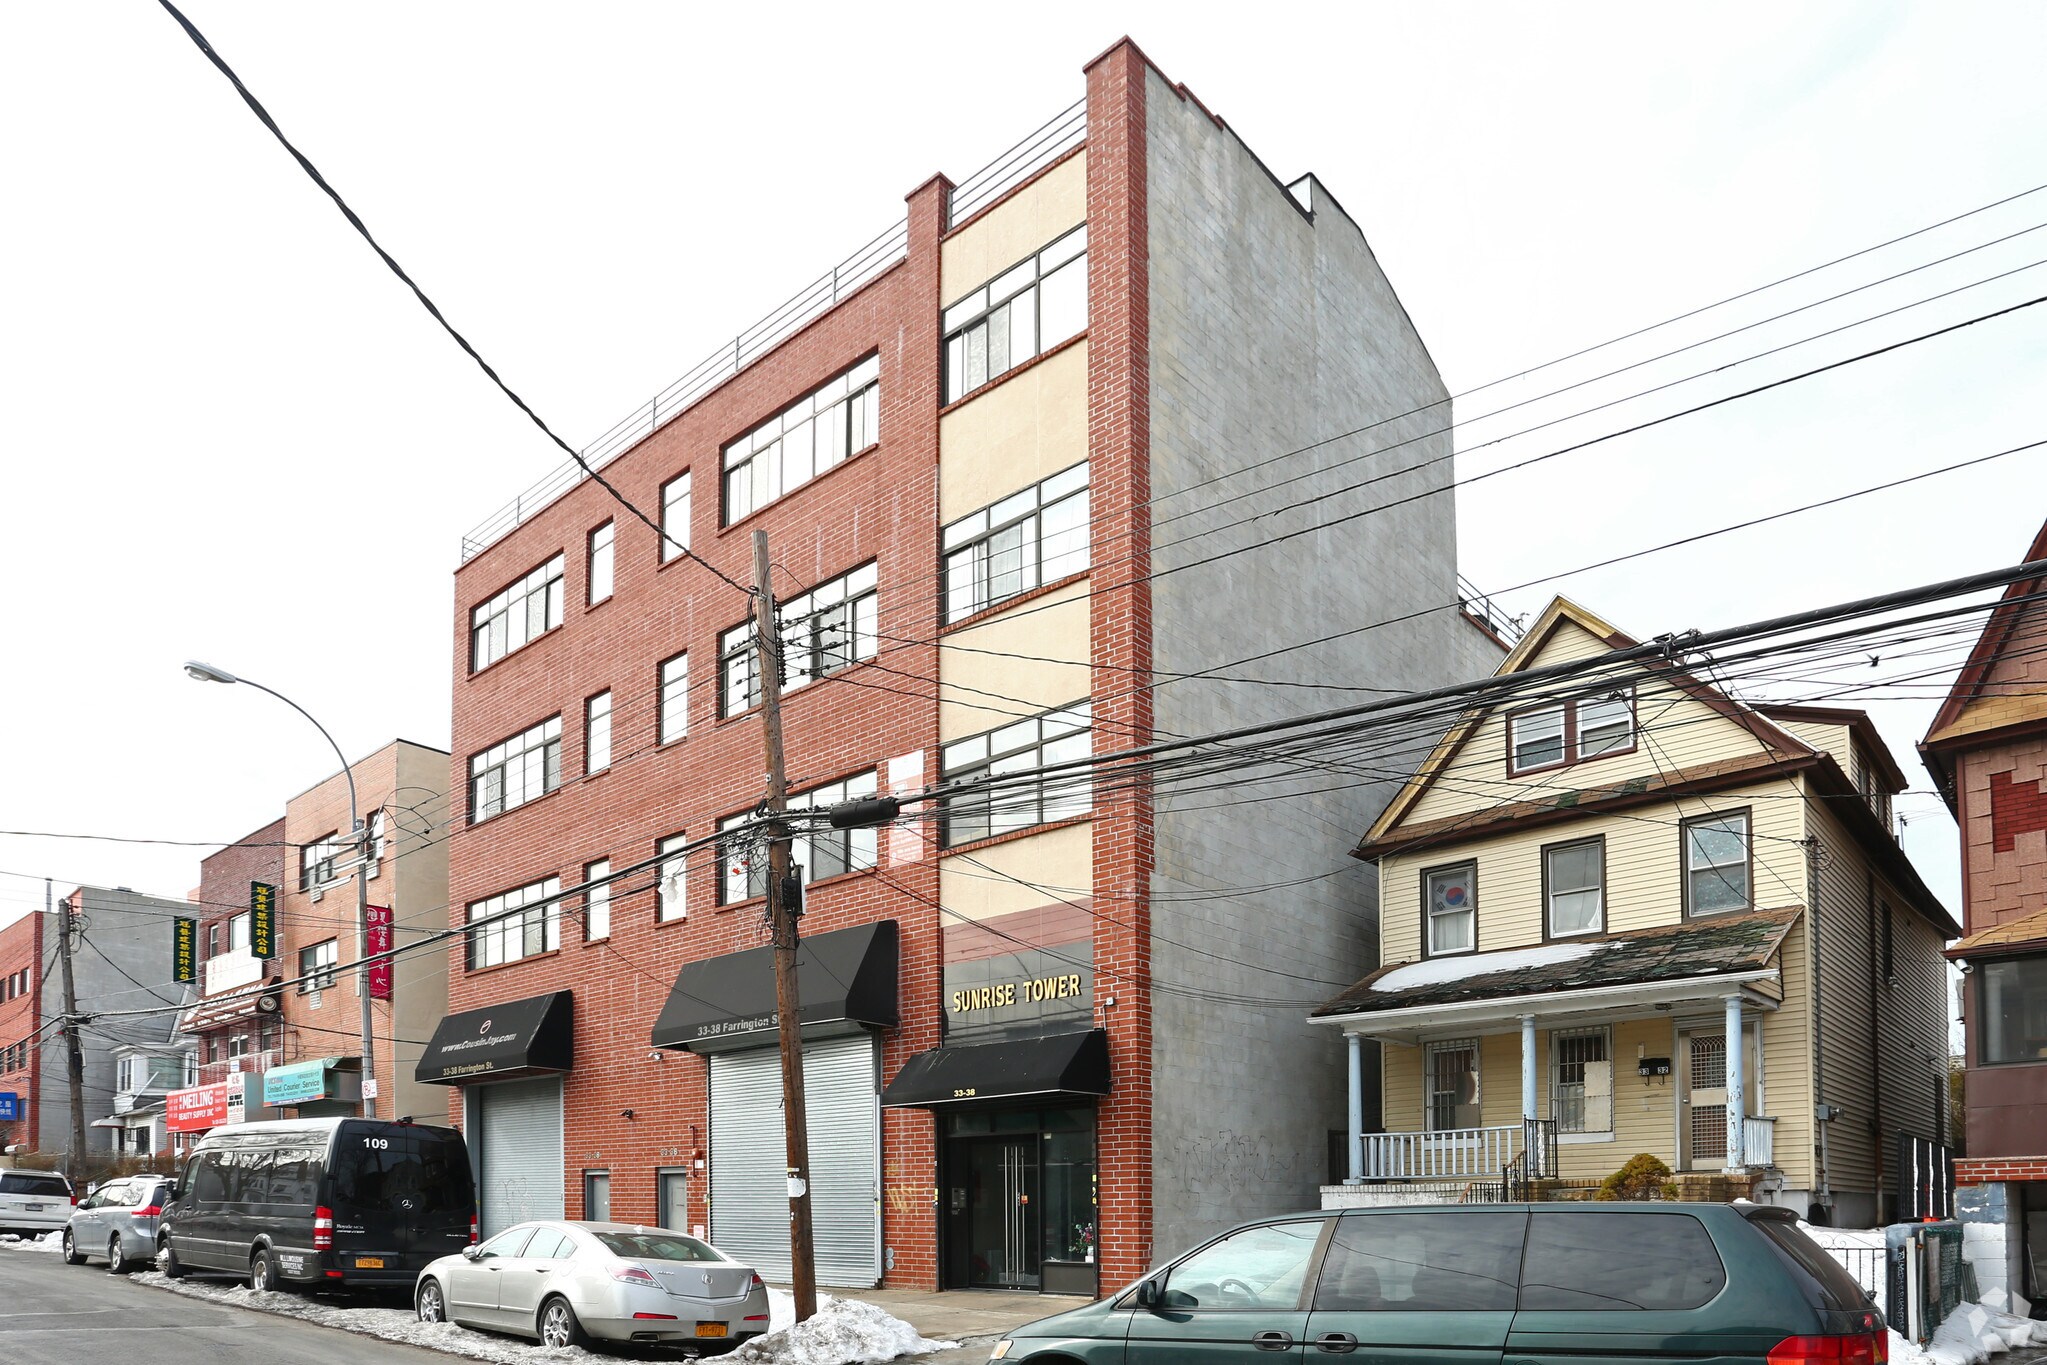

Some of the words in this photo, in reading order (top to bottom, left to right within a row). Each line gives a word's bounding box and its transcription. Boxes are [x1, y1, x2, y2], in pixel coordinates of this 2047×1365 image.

[953, 983, 1016, 1013] SUNRISE
[1023, 974, 1082, 1003] TOWER
[697, 1023, 721, 1036] 33-38
[722, 1017, 769, 1032] Farrington
[771, 1014, 780, 1024] S
[443, 1065, 458, 1076] 33-38
[458, 1063, 485, 1074] Farrington
[485, 1061, 494, 1070] St.
[267, 1085, 282, 1094] United
[283, 1083, 301, 1091] Courier
[302, 1079, 320, 1088] Service
[953, 1088, 976, 1097] 33-38
[182, 1090, 214, 1110] MEILING
[178, 1112, 193, 1121] BEAUTY
[193, 1109, 207, 1119] SUPPLY
[363, 1137, 388, 1150] 109
